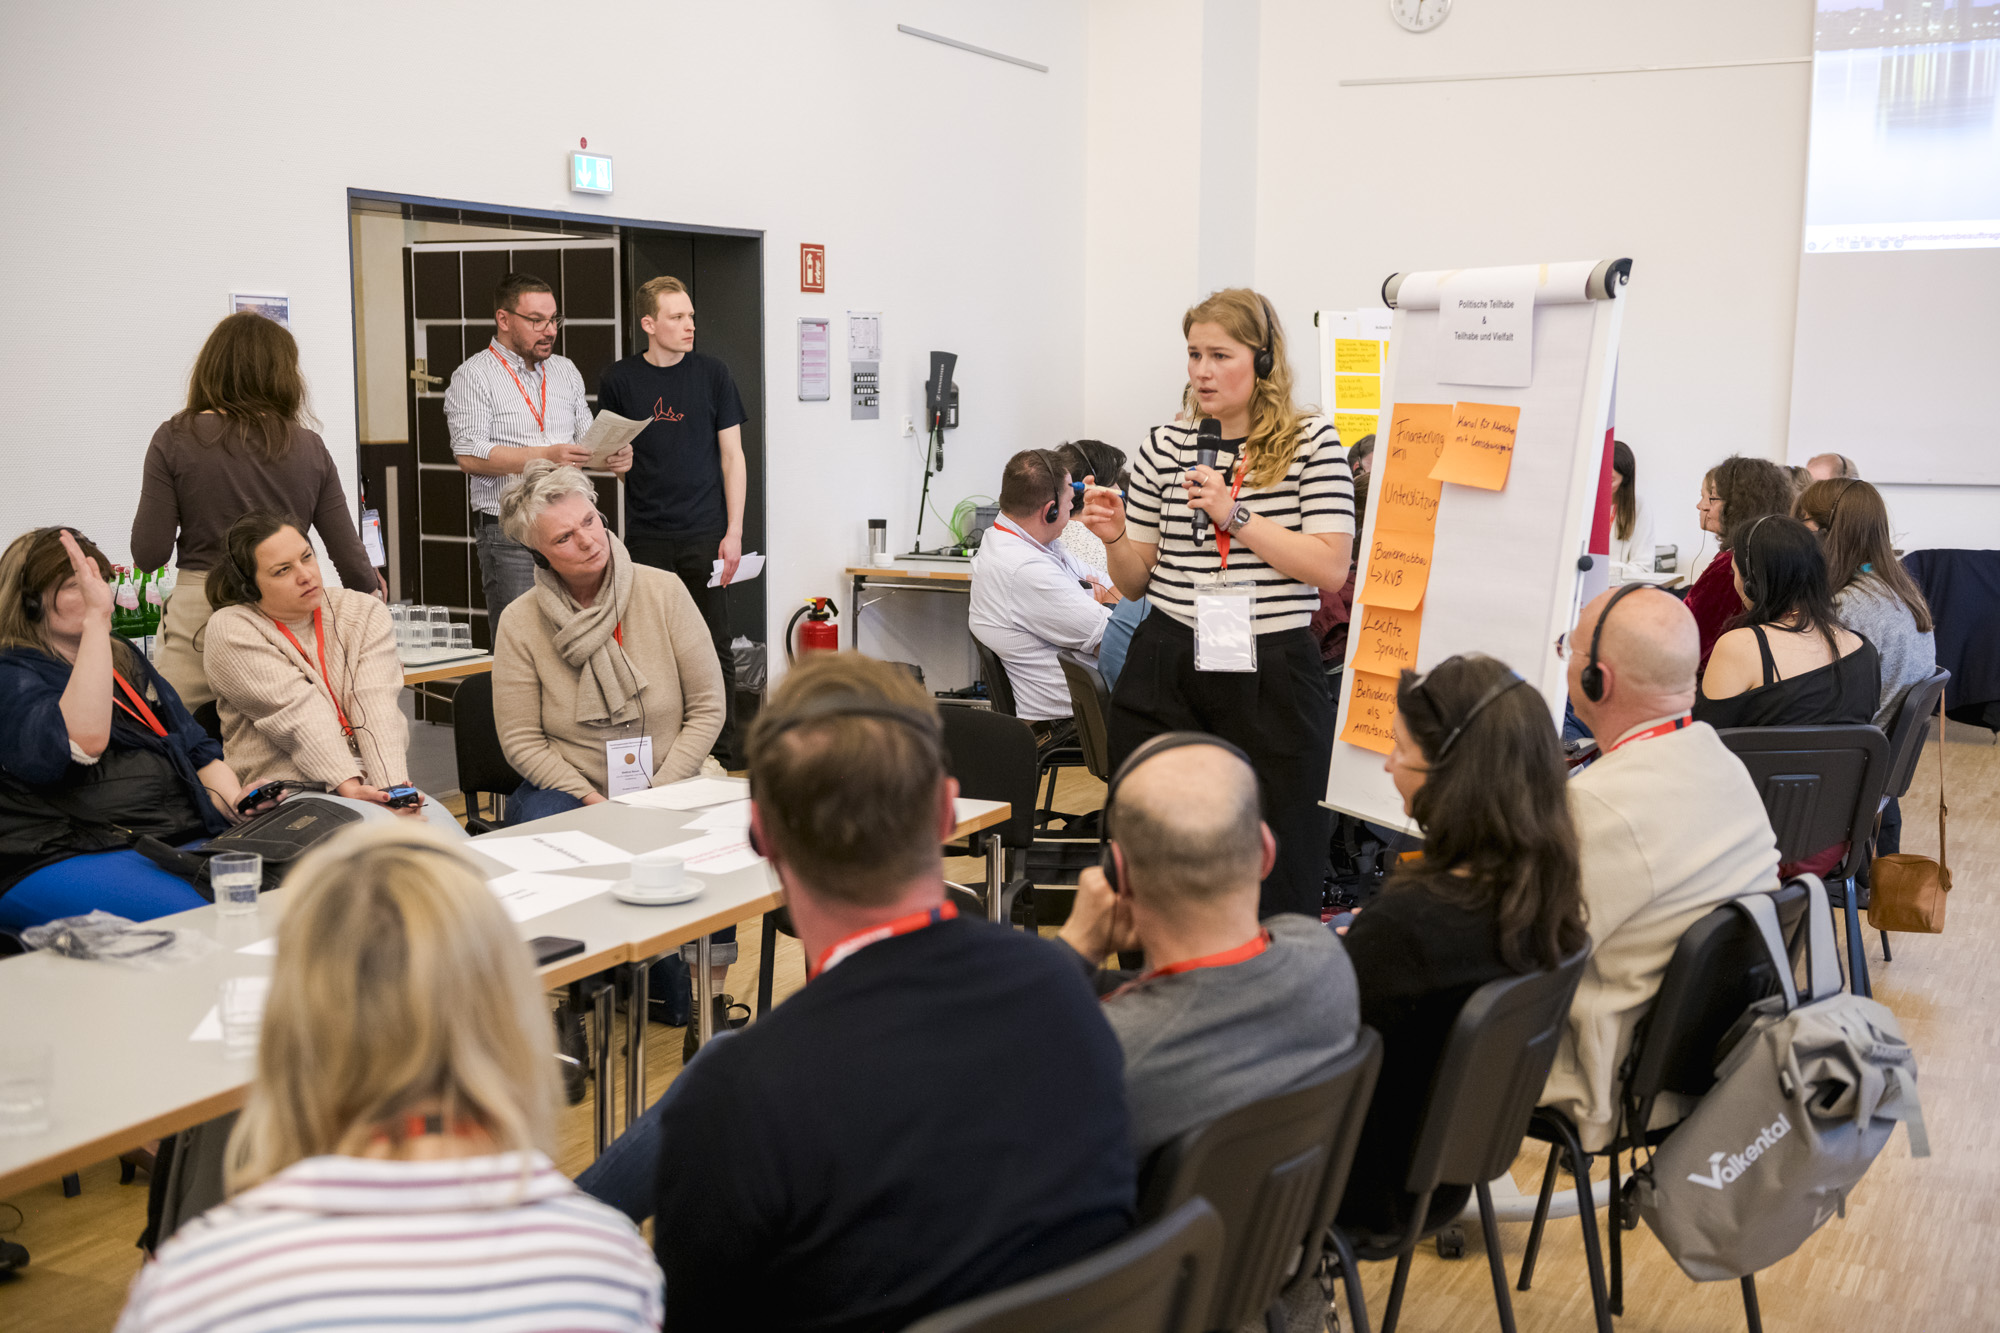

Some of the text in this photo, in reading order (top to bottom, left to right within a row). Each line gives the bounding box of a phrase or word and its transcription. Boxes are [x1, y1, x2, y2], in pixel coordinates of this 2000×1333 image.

[1459, 299, 1515, 309] Politische Teilhabe
[1482, 315, 1487, 325] &
[1454, 331, 1514, 341] Teilhabe und Vielfalt
[1395, 418, 1446, 458] Finanzierung
[1383, 568, 1404, 587] KVB
[1363, 611, 1402, 638] Leichte
[1374, 638, 1408, 662] Sprache
[1367, 705, 1380, 720] als
[1687, 1112, 1792, 1190] Valkental
